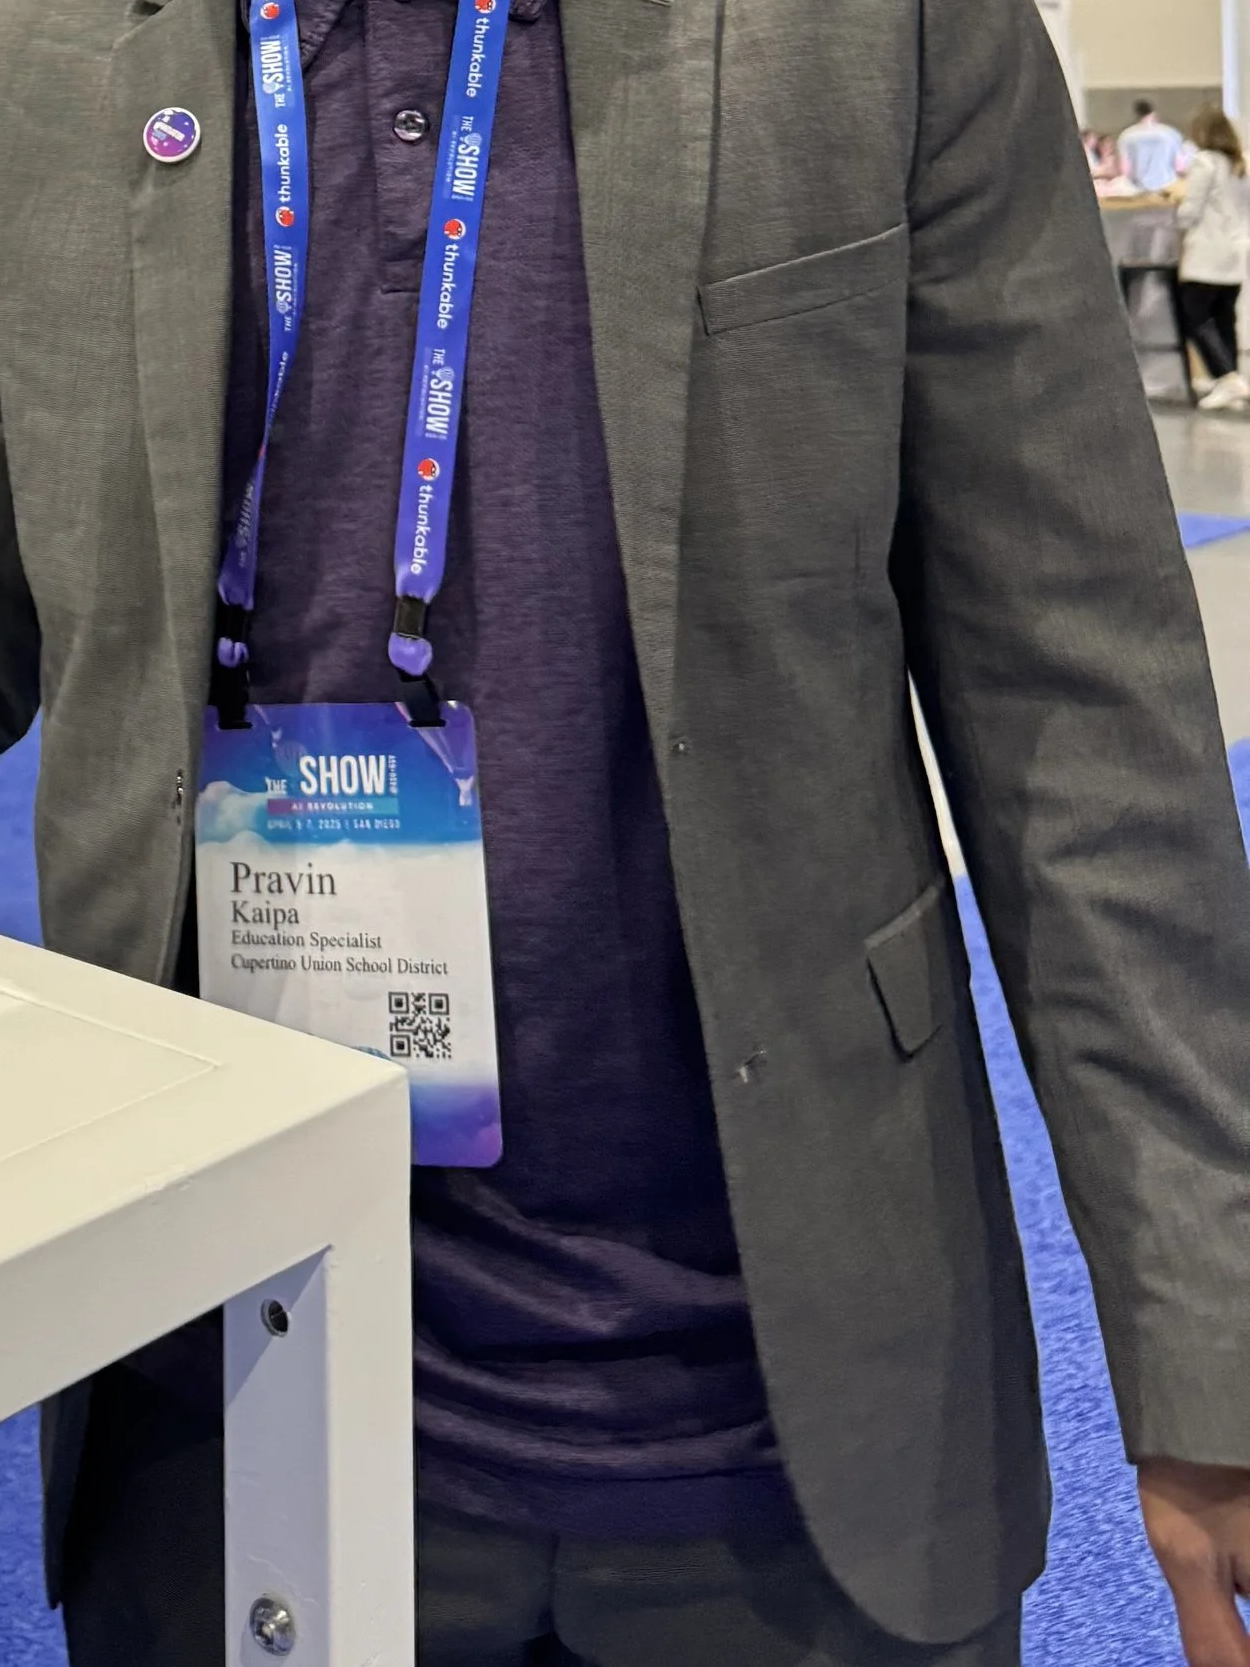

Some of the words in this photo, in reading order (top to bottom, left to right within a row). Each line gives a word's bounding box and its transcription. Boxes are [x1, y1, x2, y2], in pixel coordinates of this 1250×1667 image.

[260, 40, 285, 83] SHOW
[466, 16, 489, 98] thunkable
[274, 93, 286, 108] THE
[461, 116, 474, 132] THE
[275, 123, 291, 202] thunkable
[453, 143, 480, 196] SHOW
[274, 249, 292, 303] SHOW
[437, 243, 459, 329] thunkable
[284, 317, 292, 332] THE
[432, 348, 445, 365] THE
[425, 380, 452, 435] SHOW
[411, 485, 434, 575] thunkable
[265, 777, 287, 795] THE
[300, 754, 387, 796] SHOW
[291, 803, 303, 811] AI
[307, 802, 374, 812] REVOLUTION
[230, 861, 337, 895] Pravin
[231, 900, 300, 930] Kaipa
[231, 930, 305, 947] Education
[310, 932, 382, 951] Specialist
[231, 954, 296, 973] Cupertino
[300, 955, 342, 972] Union
[346, 957, 393, 974] School
[397, 958, 449, 975] District
